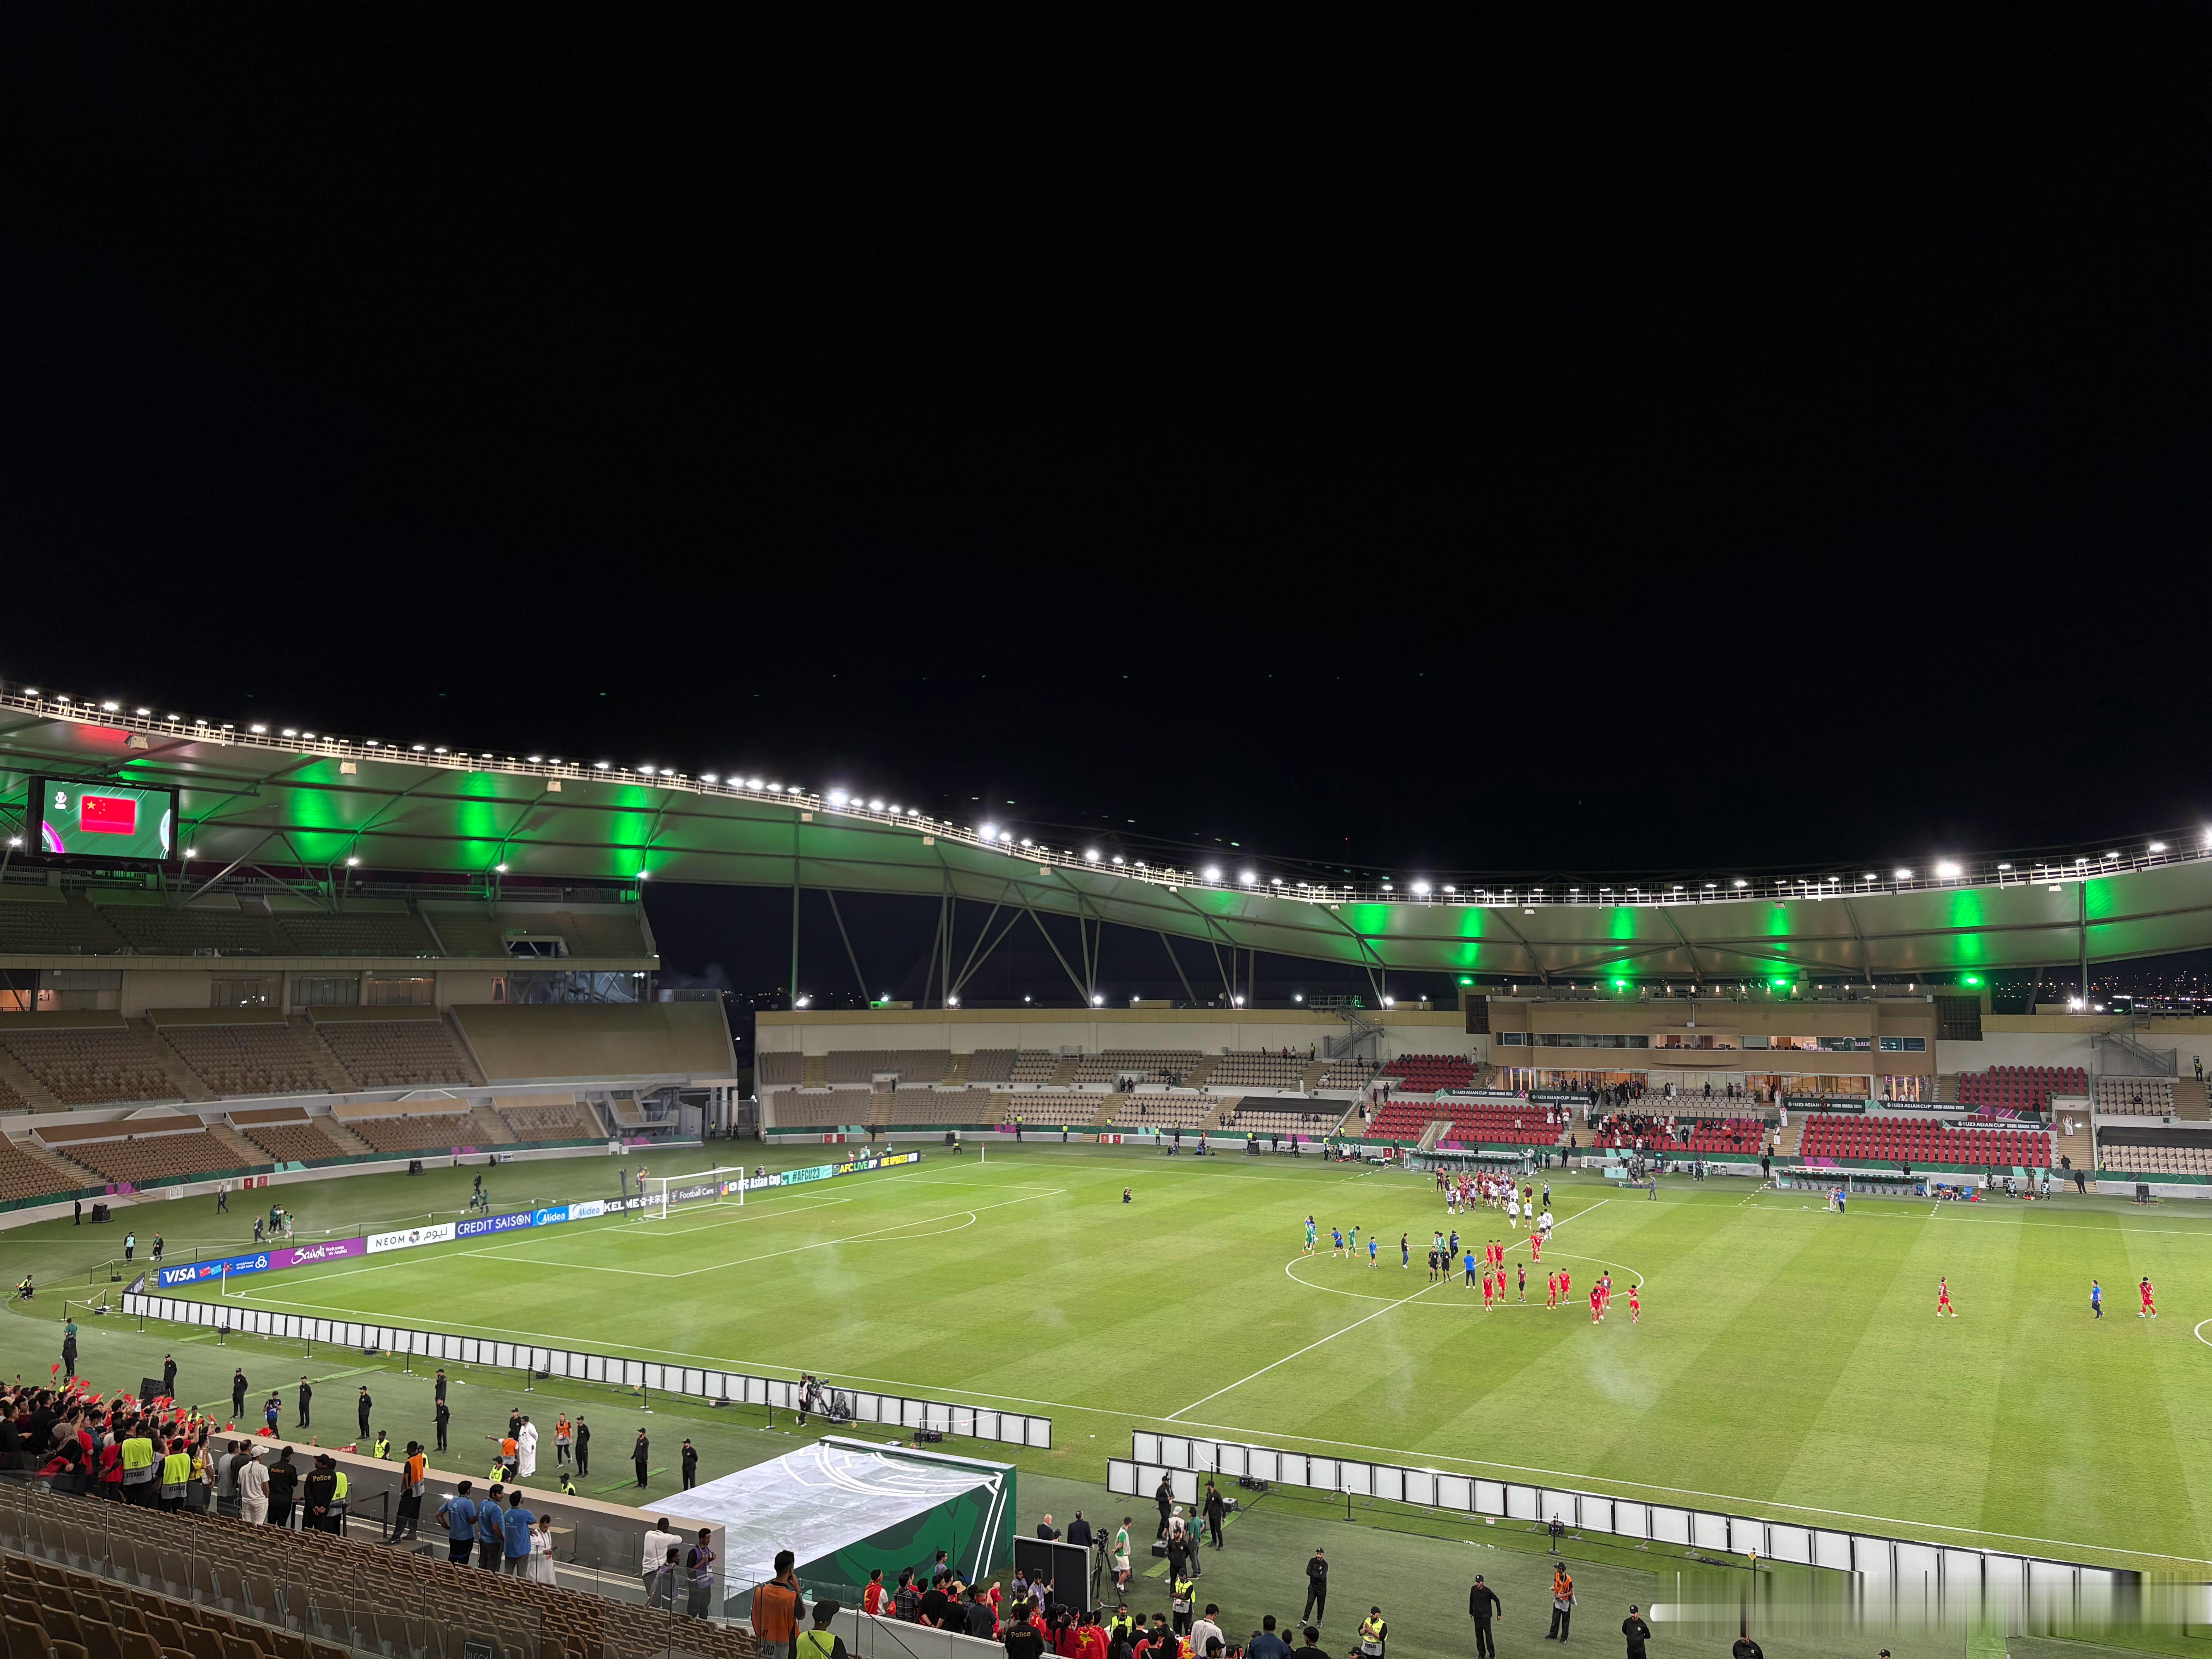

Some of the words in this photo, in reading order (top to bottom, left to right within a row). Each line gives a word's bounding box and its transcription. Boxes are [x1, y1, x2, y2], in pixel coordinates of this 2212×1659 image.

[839, 1163, 854, 1173] AFC
[854, 1161, 868, 1171] LIVE
[750, 1176, 768, 1189] Asian
[769, 1175, 780, 1186] Cup
[792, 1168, 820, 1182] #AFCU23
[679, 1188, 701, 1199] Football
[573, 1204, 599, 1219] Midea
[604, 1198, 639, 1212] KELME
[457, 1219, 493, 1235] CREDIT
[495, 1213, 531, 1229] SAISON
[536, 1209, 565, 1225] Midea
[376, 1235, 405, 1247] NEOM
[424, 1227, 447, 1241] نيوم
[163, 1267, 196, 1283] VISA
